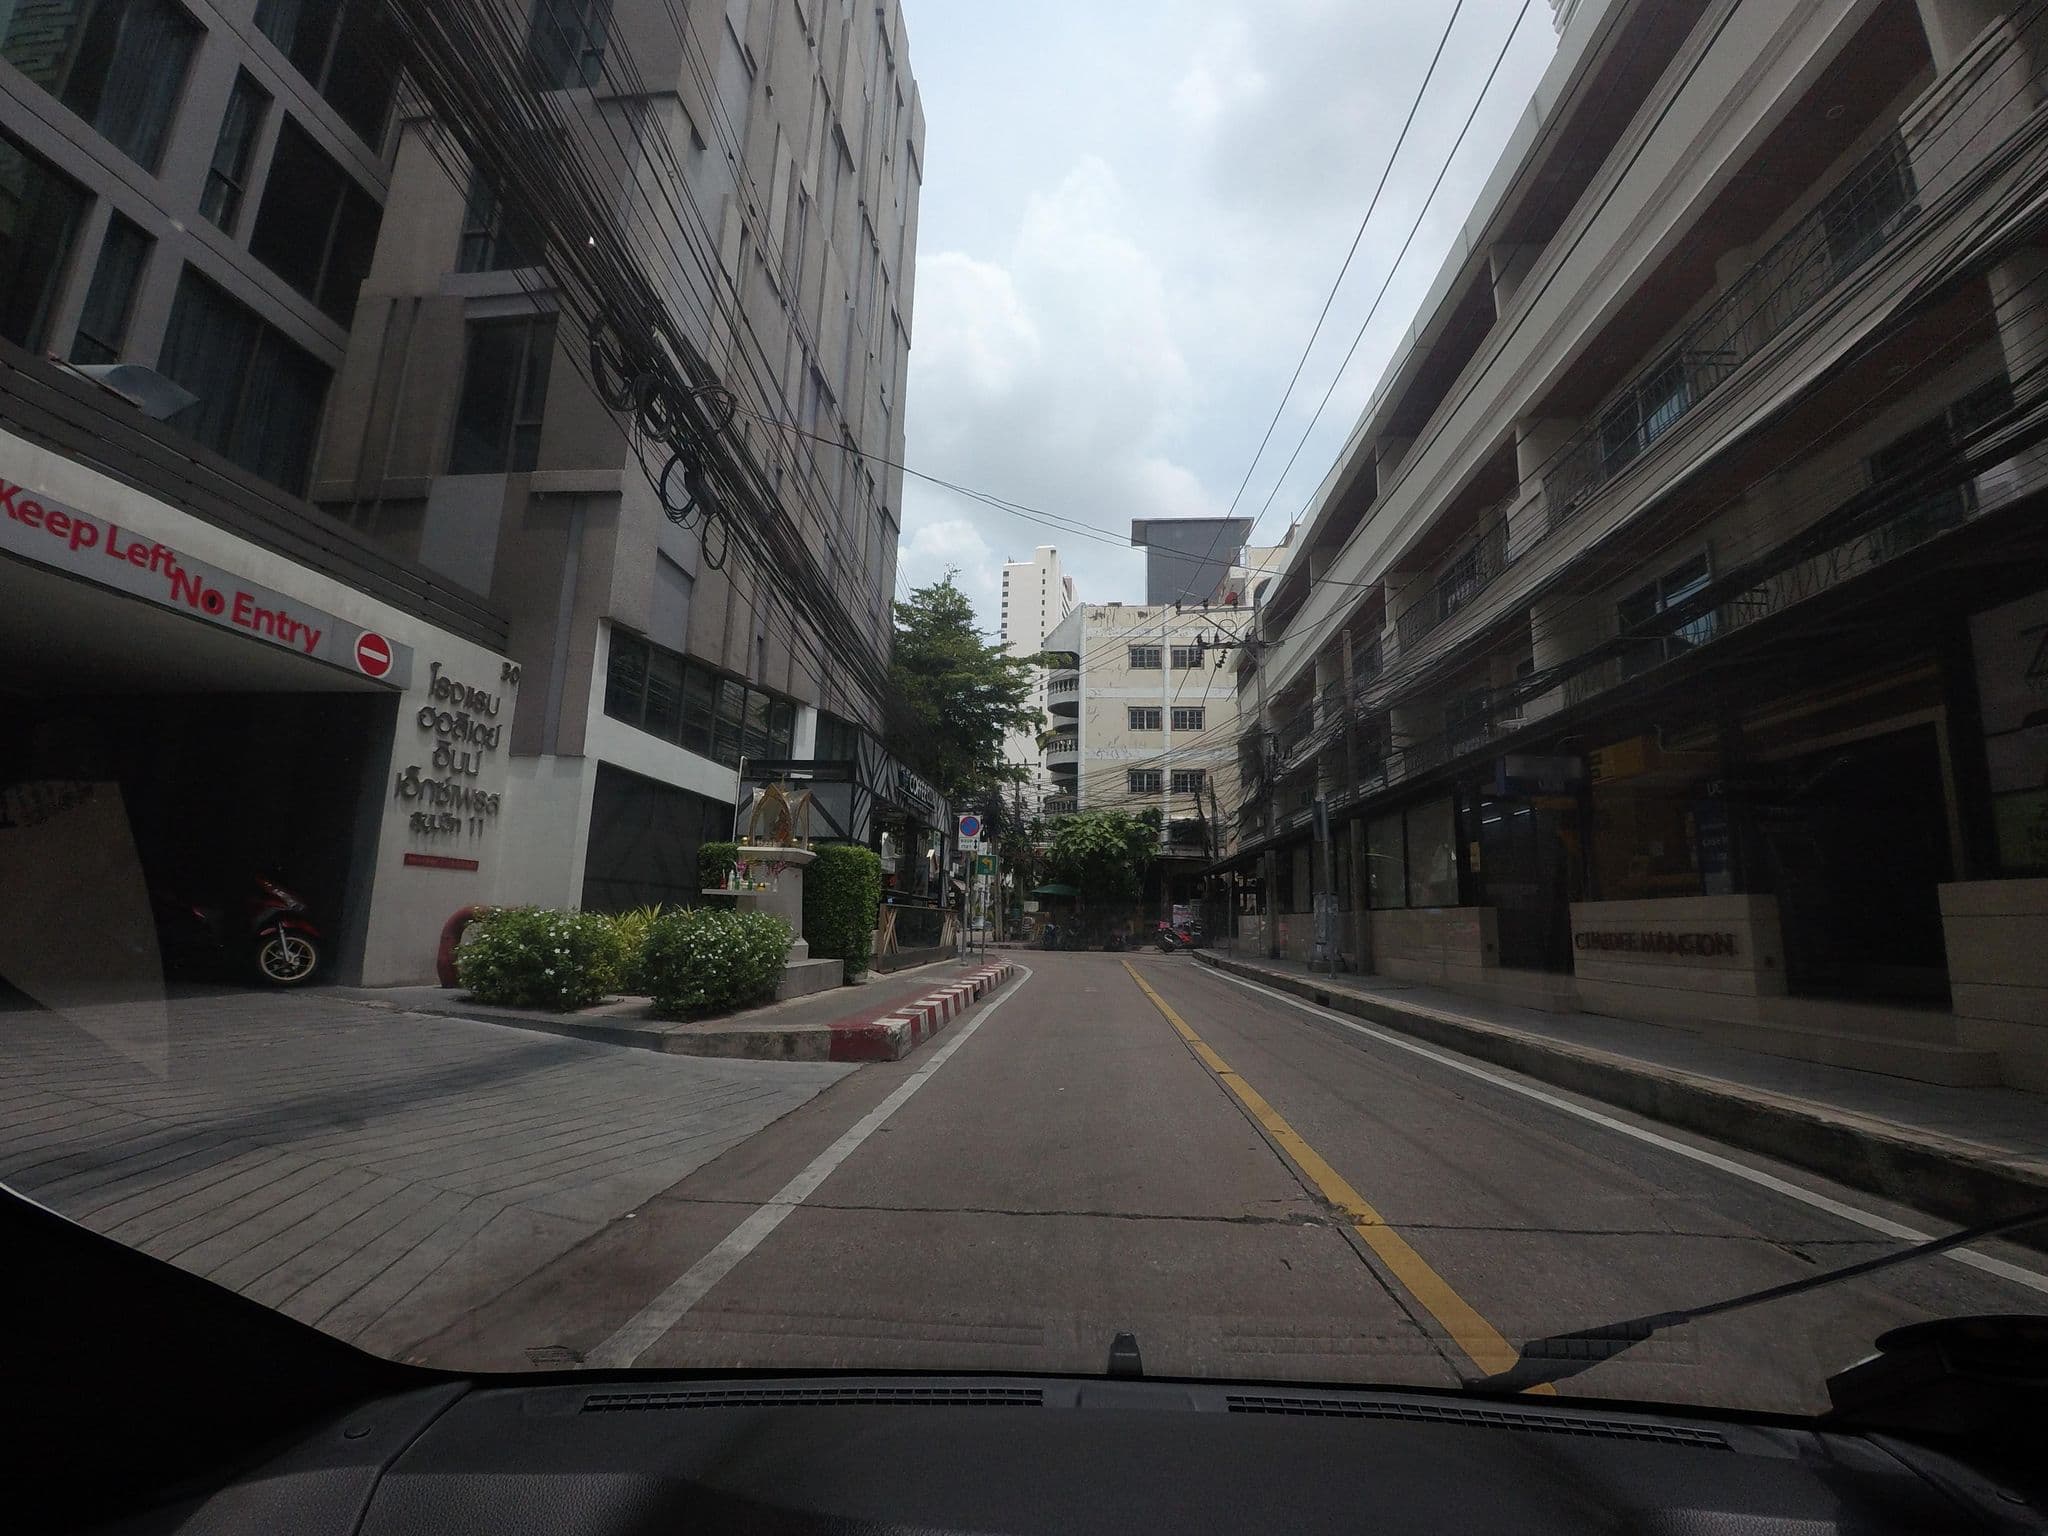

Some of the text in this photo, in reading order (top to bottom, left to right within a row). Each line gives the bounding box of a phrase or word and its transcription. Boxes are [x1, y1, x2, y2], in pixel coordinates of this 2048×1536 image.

[0, 478, 177, 579] Keep Left
[170, 566, 323, 655] No Entry
